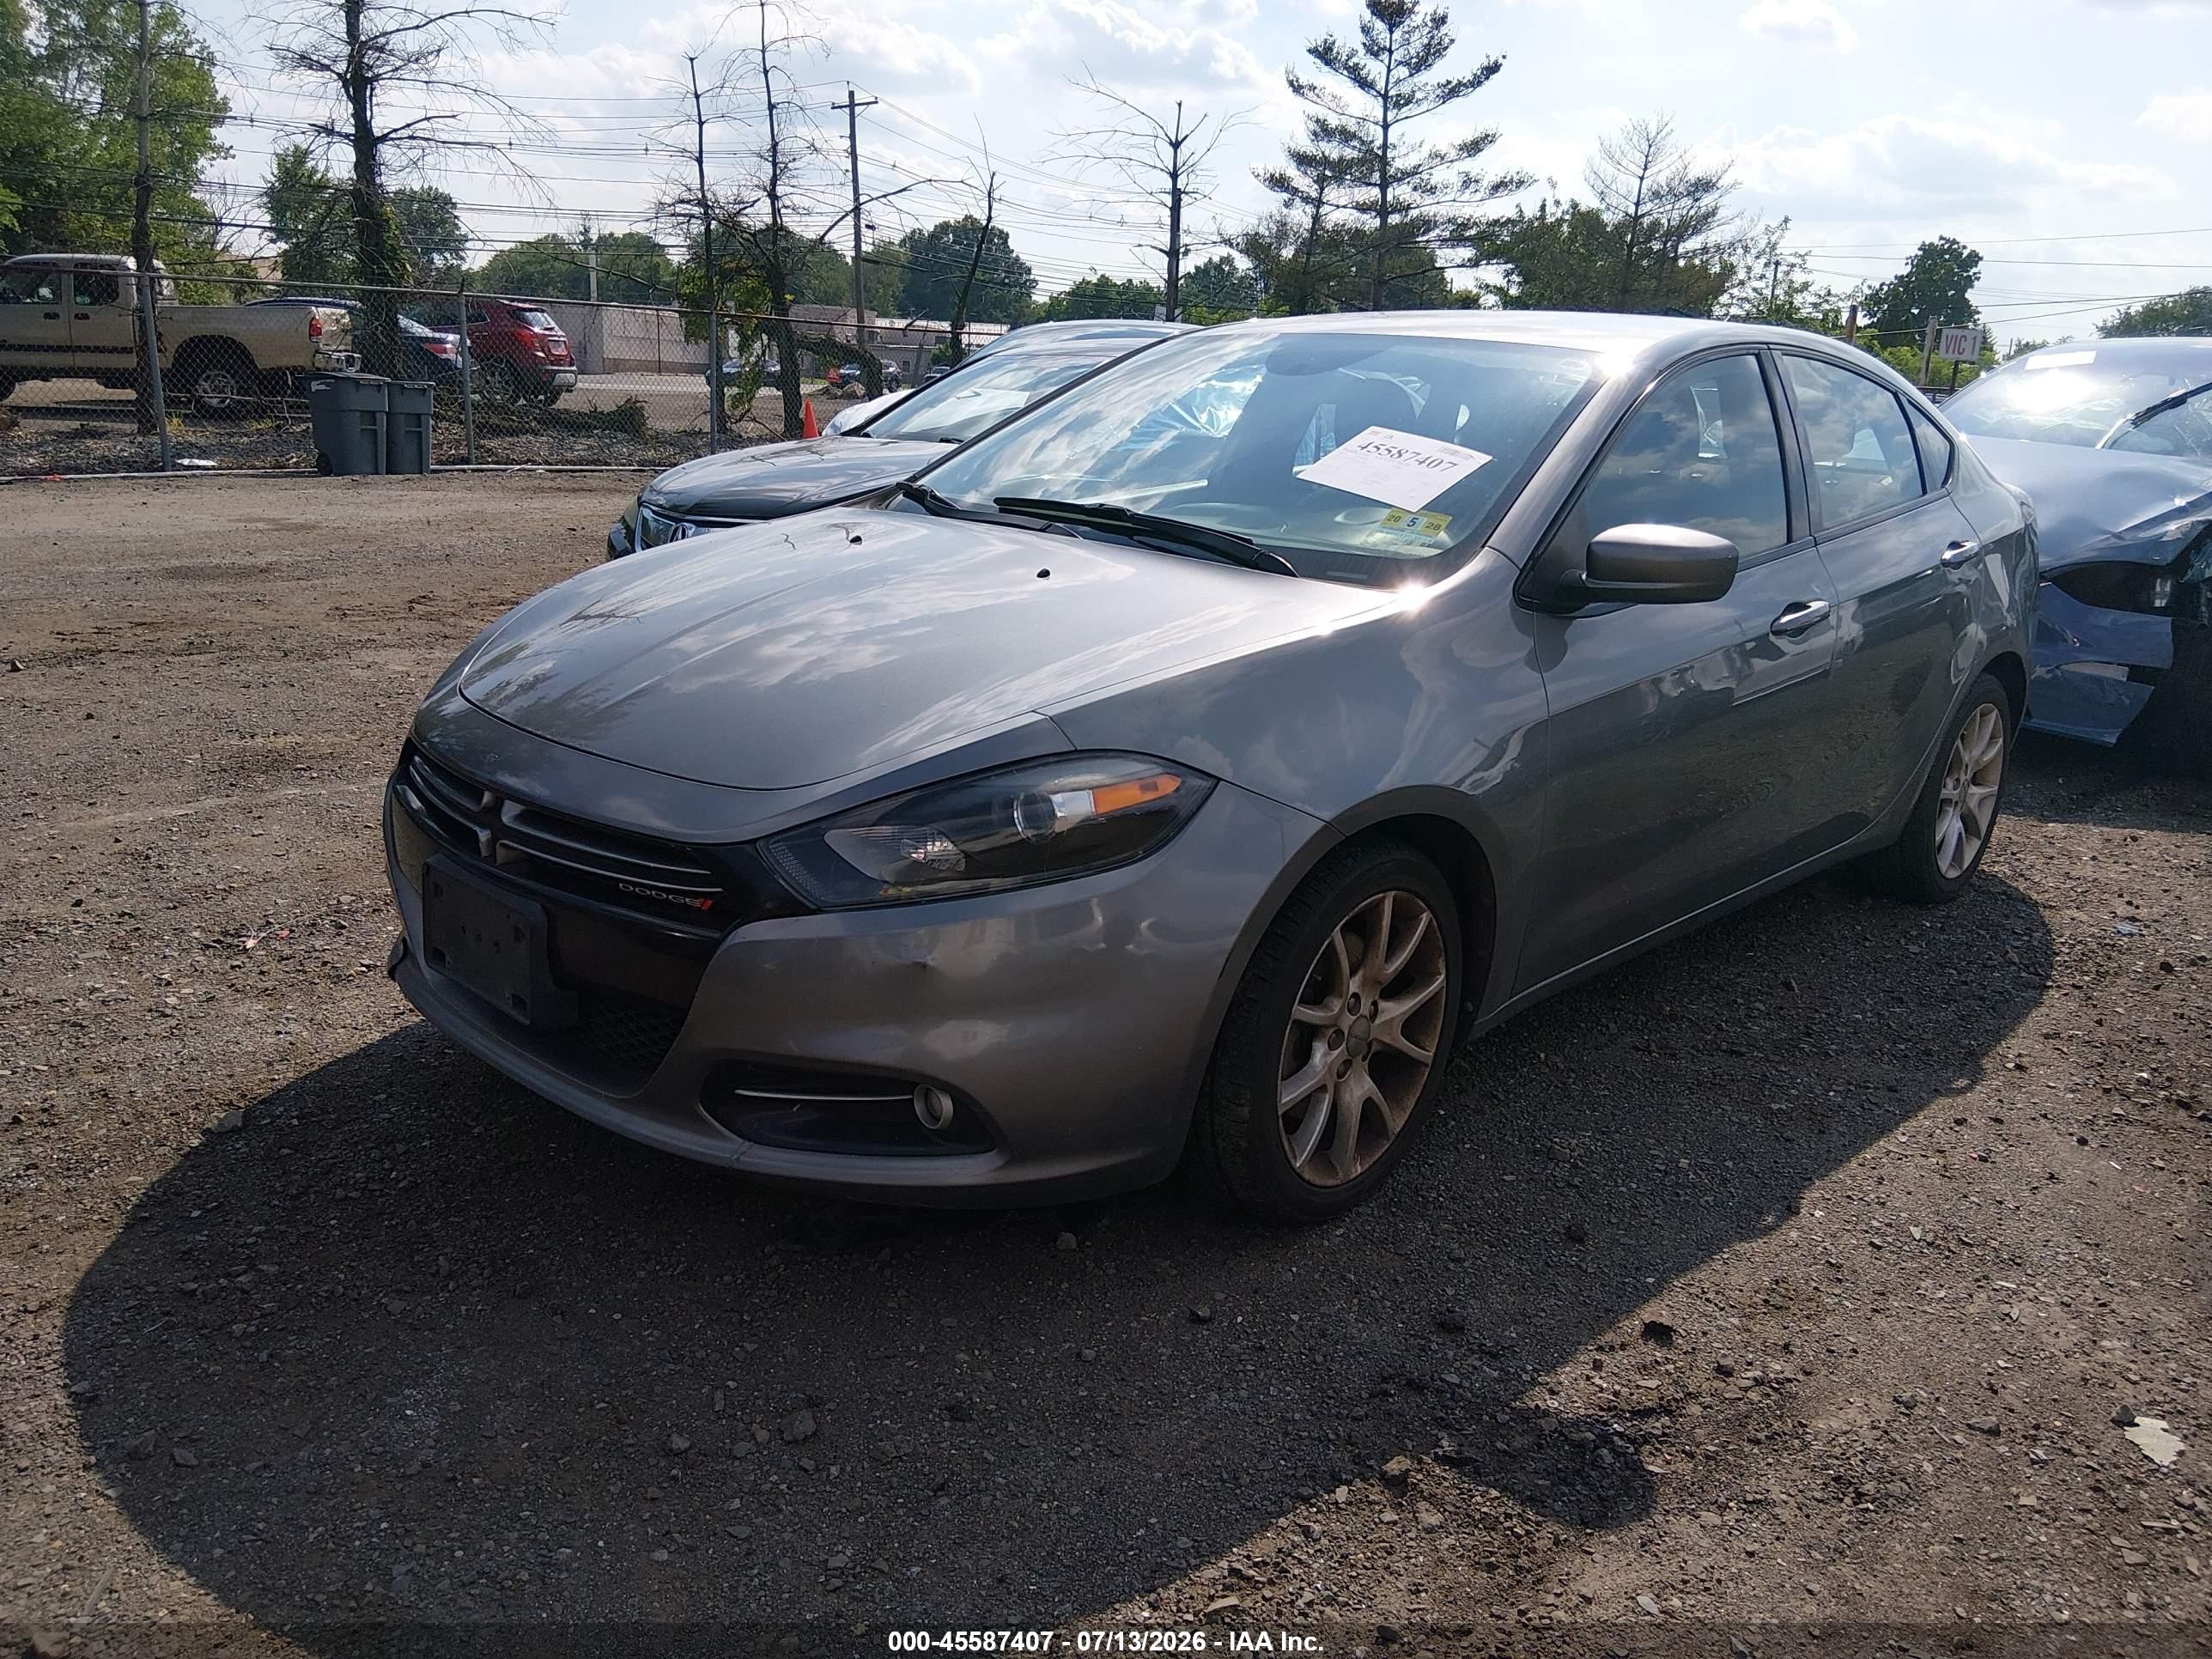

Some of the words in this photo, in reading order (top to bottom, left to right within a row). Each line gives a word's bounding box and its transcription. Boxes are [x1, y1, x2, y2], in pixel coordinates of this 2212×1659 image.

[1945, 334, 1967, 356] VIC
[1972, 336, 1977, 356] 1
[1357, 441, 1459, 472] 45587407
[1387, 514, 1402, 523] 20
[1407, 517, 1419, 527] 5
[1425, 522, 1443, 531] 28
[618, 883, 702, 907] DODGE
